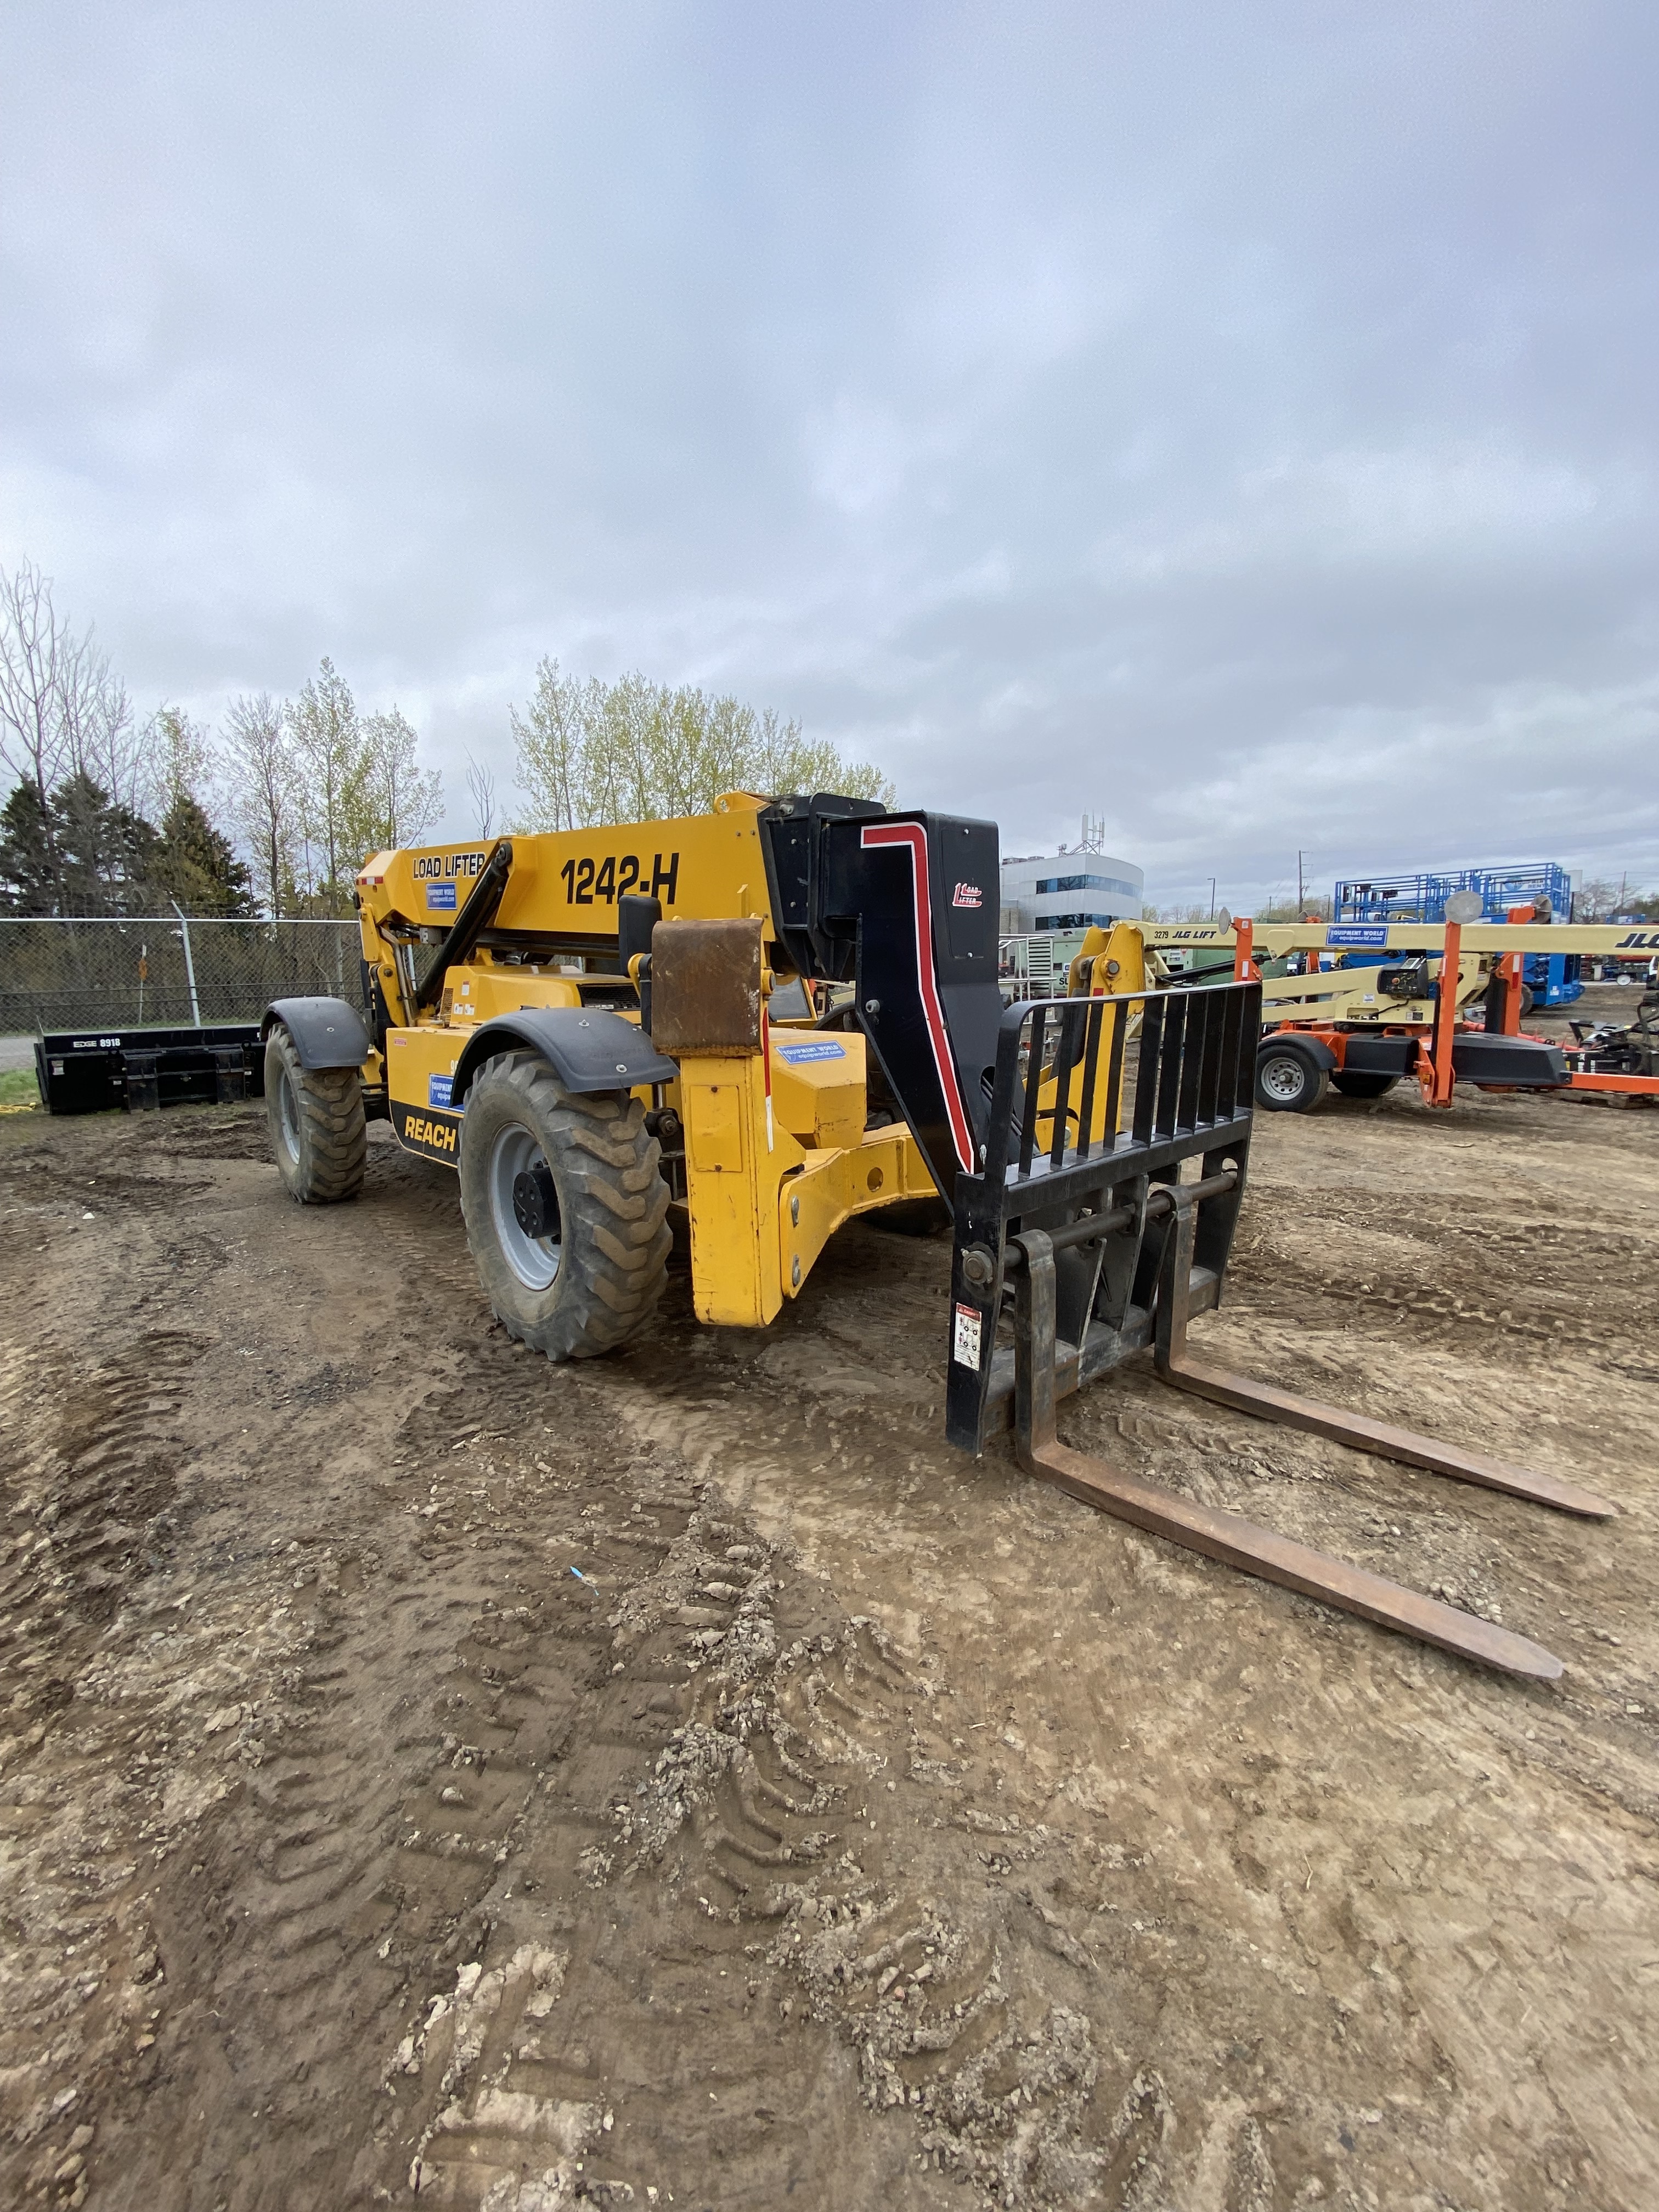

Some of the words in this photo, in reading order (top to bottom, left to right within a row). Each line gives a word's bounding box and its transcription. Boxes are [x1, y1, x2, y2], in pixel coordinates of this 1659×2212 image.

[413, 856, 441, 879] LOAD
[561, 853, 679, 904] 1242-H
[961, 883, 982, 896] LOAD
[100, 1038, 121, 1047] 8918
[783, 1047, 817, 1055] EQUIPMENT
[798, 1050, 843, 1059] equipworld.com
[404, 1115, 456, 1152] REACH
